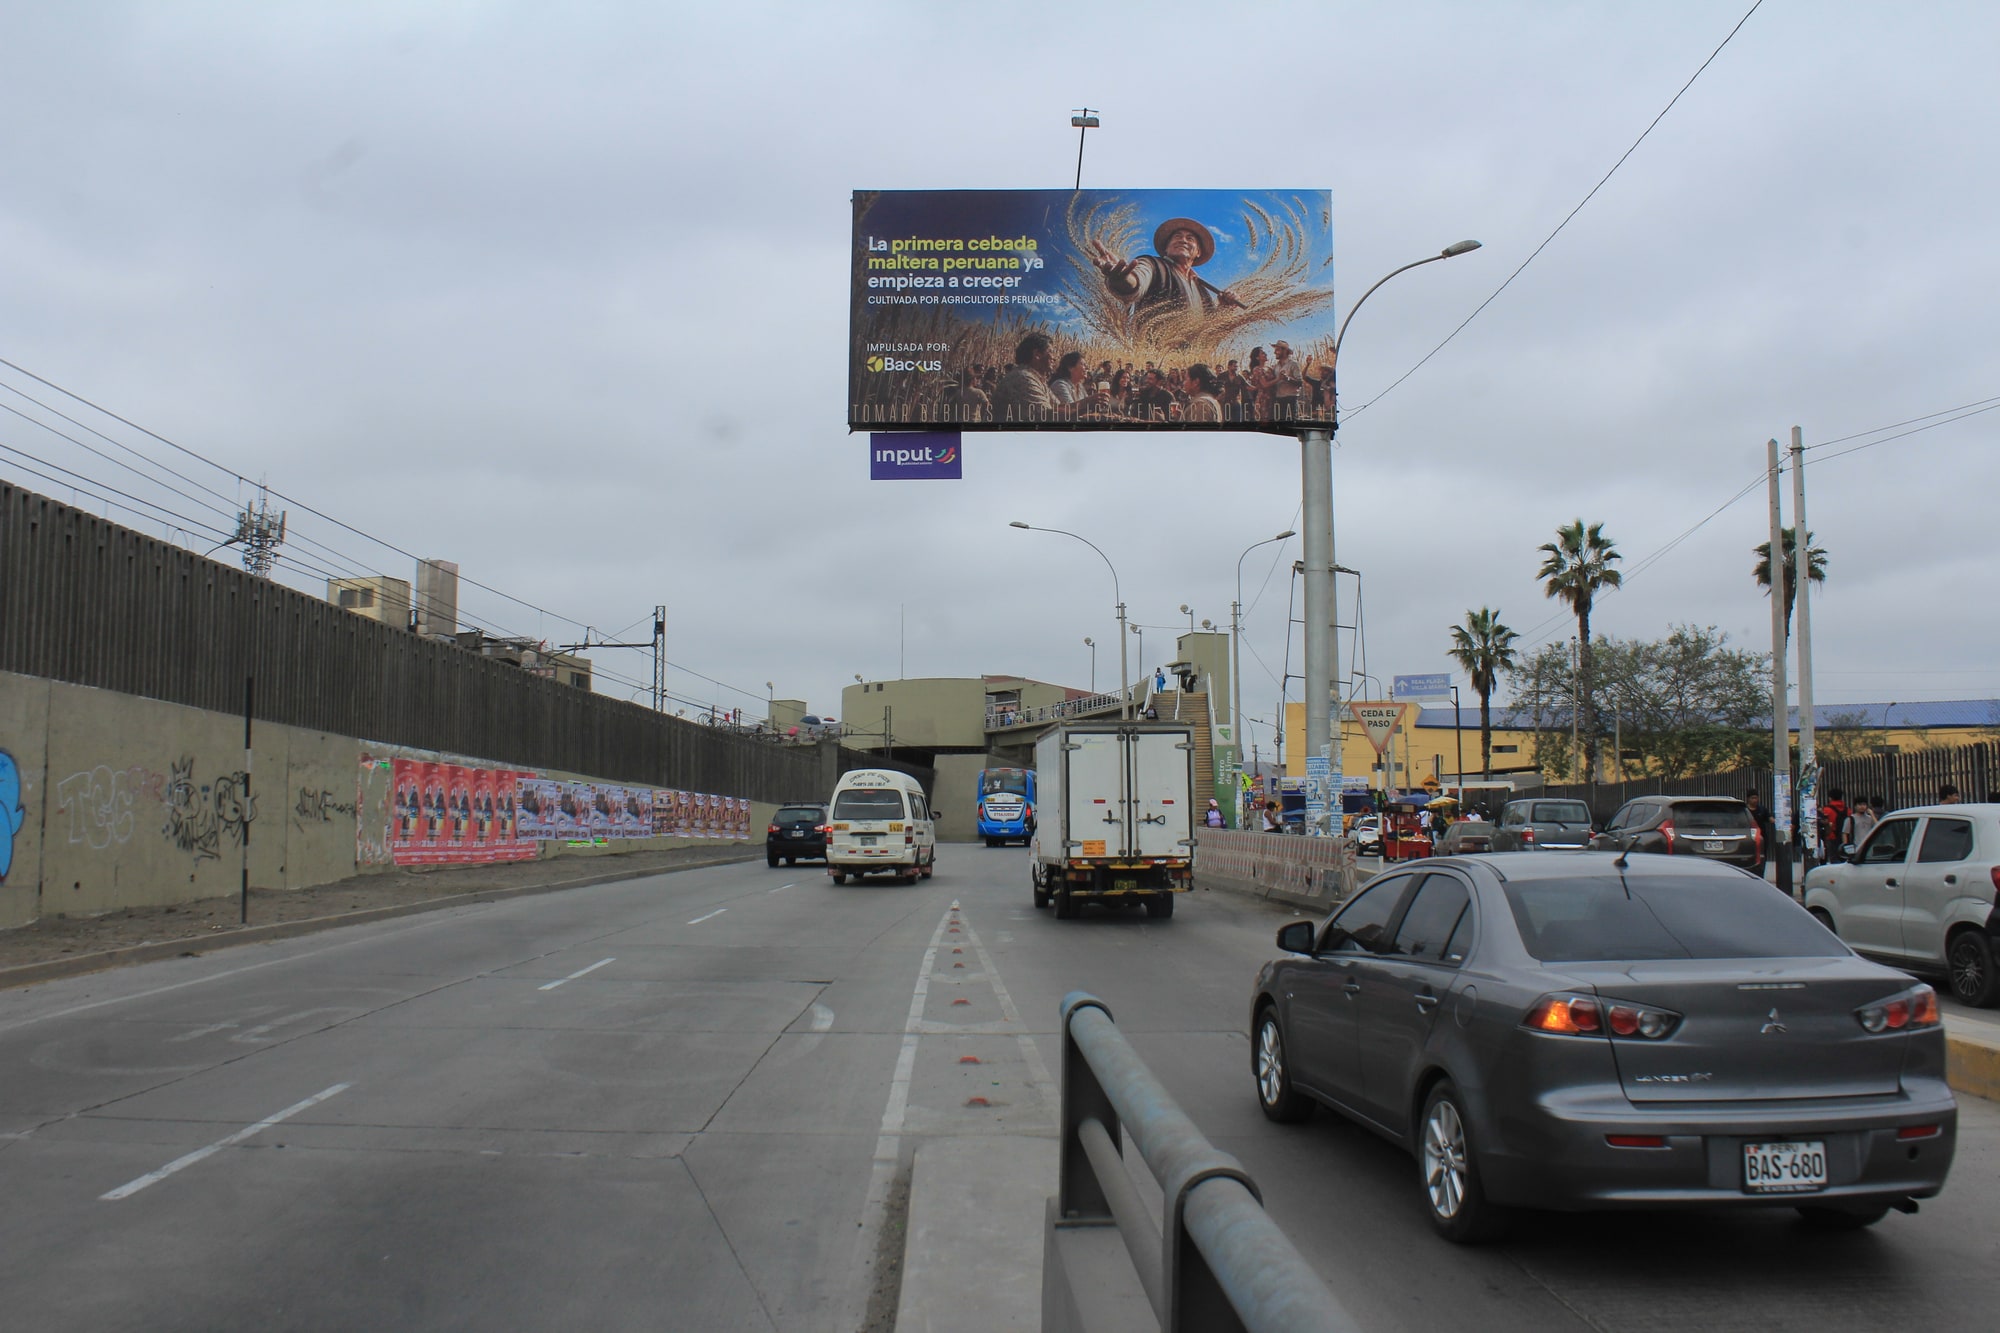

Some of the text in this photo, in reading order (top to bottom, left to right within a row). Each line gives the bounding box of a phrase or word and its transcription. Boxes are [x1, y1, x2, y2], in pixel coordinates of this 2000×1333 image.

[868, 235, 1038, 254] La primera cebada
[868, 254, 1044, 272] maltera peruana ya
[868, 272, 1022, 291] empieza a crecer
[868, 294, 1060, 304] CULTIVADA POR AGRICULTORES PERUANOS
[866, 342, 950, 352] IMPULSADA POR:
[852, 404, 908, 422] TOMAR
[921, 404, 994, 423] BEBIDAS
[1168, 402, 1231, 422] EXCESO
[1244, 402, 1262, 422] ES
[876, 446, 932, 466] input
[1360, 709, 1396, 718] CEDA EL
[1226, 772, 1232, 784] de
[1748, 1153, 1823, 1180] BAS-680
